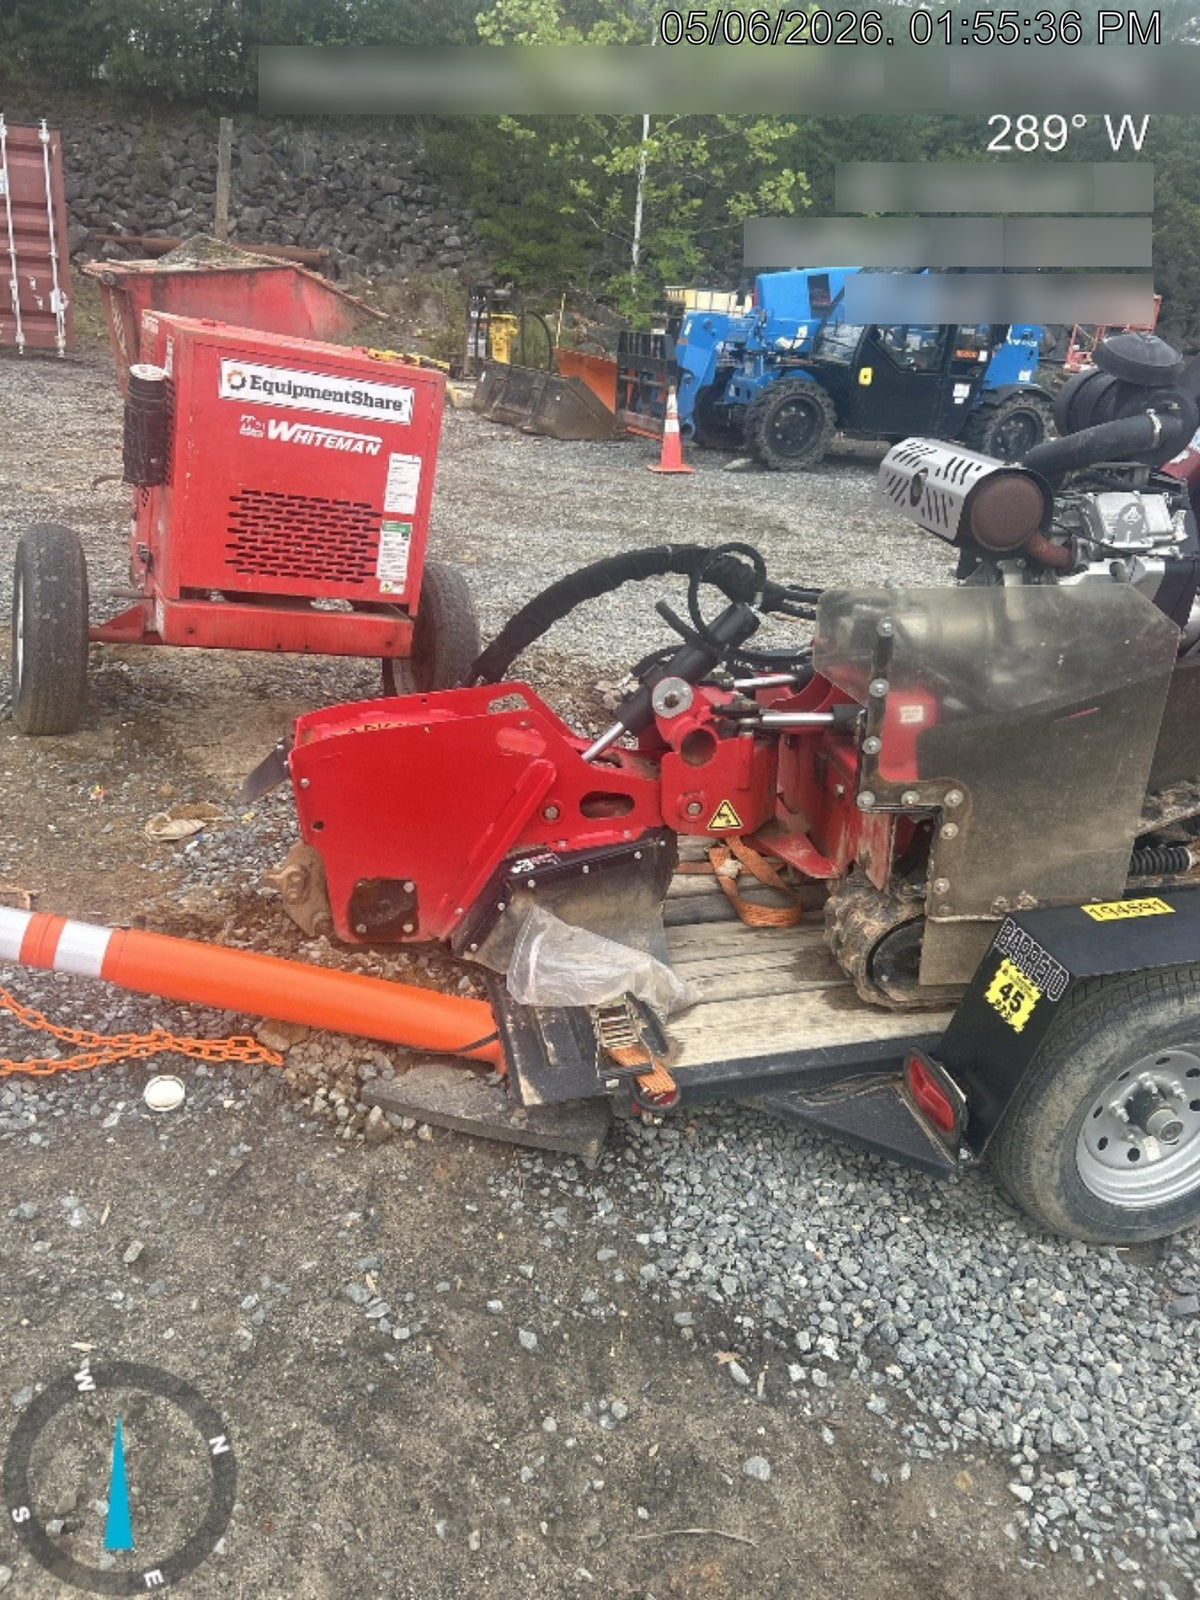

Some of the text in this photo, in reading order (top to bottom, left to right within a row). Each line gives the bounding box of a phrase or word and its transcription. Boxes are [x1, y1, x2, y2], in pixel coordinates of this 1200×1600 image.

[249, 374, 403, 412] EquipmentShare
[994, 916, 1070, 1002] BARRETO
[999, 982, 1025, 1013] 45
